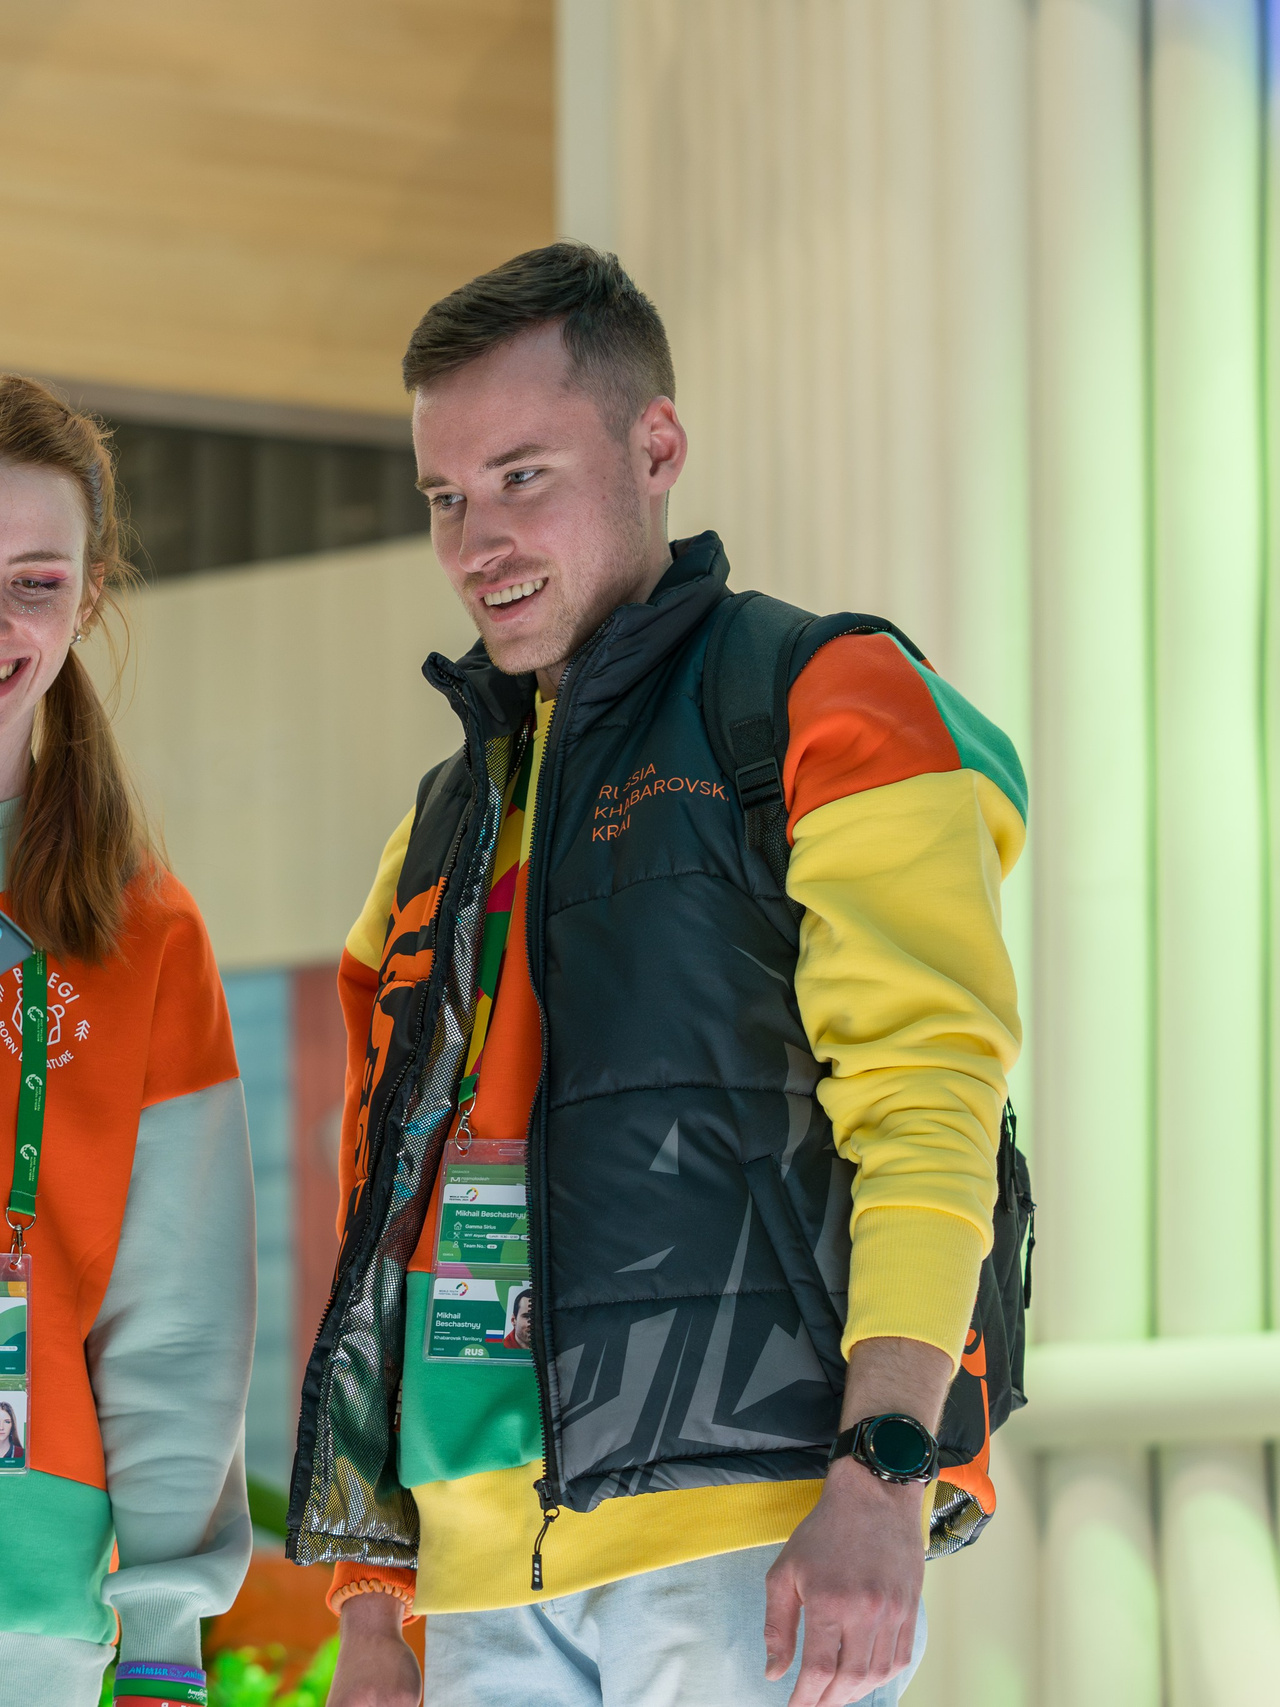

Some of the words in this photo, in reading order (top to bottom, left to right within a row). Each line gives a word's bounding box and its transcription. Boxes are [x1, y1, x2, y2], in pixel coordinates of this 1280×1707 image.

[594, 777, 729, 820] KHABAROVSK
[592, 814, 631, 842] KRAI
[12, 967, 80, 1004] BEGI
[47, 1050, 75, 1070] ATURE
[481, 1210, 526, 1220] Beschastnyy
[435, 1320, 481, 1330] Beschastnyy
[464, 1348, 484, 1356] RUS
